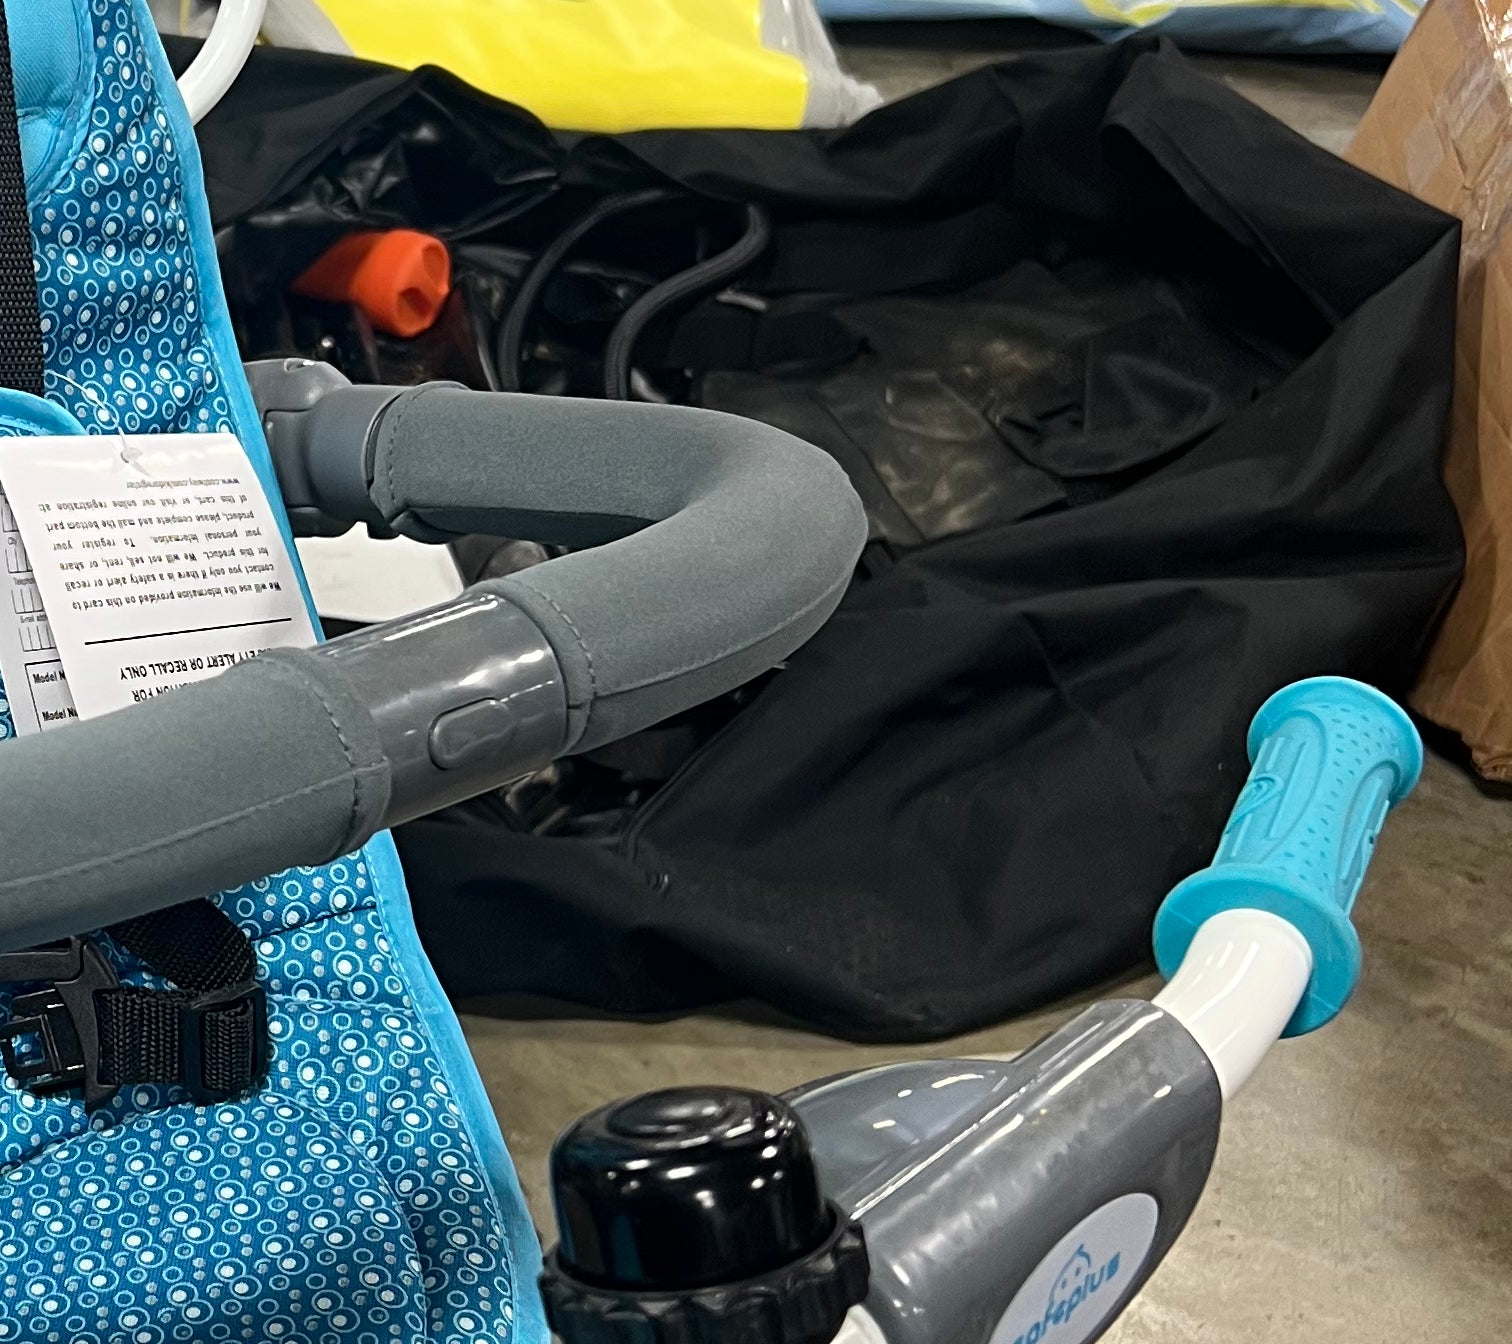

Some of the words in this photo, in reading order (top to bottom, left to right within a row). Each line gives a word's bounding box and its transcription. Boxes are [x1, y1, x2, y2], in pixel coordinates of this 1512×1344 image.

[239, 495, 247, 503] of
[56, 499, 107, 511] registration
[112, 500, 137, 509] online
[138, 517, 153, 527] and
[156, 514, 193, 525] complete
[196, 512, 221, 523] please
[45, 521, 65, 532] part
[67, 521, 100, 530] bottom
[101, 520, 116, 528] the
[117, 519, 135, 529] mail
[205, 529, 238, 541] personal
[245, 527, 262, 537] your
[53, 539, 74, 551] your
[82, 537, 116, 549] register
[123, 538, 135, 547] To
[240, 548, 254, 557] this
[258, 547, 269, 556] for
[148, 555, 162, 565] not
[166, 554, 180, 563] will
[184, 553, 197, 561] We
[59, 561, 85, 571] share
[90, 560, 98, 568] or
[101, 557, 123, 568] rent,
[209, 567, 225, 577] only
[228, 564, 242, 573] you
[245, 564, 274, 574] contact
[130, 573, 157, 585] safety
[159, 573, 165, 581] a
[178, 571, 199, 580] there
[202, 570, 208, 579] if
[65, 581, 91, 592] recall
[94, 579, 103, 587] or
[106, 577, 127, 587] alert
[269, 582, 281, 591] We
[177, 587, 222, 599] information
[224, 586, 237, 595] the
[239, 584, 252, 592] use
[254, 583, 267, 593] will
[106, 597, 123, 607] this
[126, 596, 136, 604] on
[139, 590, 175, 605] provided
[73, 602, 82, 611] to
[83, 599, 103, 611] card
[190, 657, 204, 670] OR
[207, 653, 235, 668] ALERT
[120, 665, 147, 680] ONLY
[149, 660, 187, 676] RECALL
[32, 671, 58, 684] Model
[42, 708, 66, 721] Model
